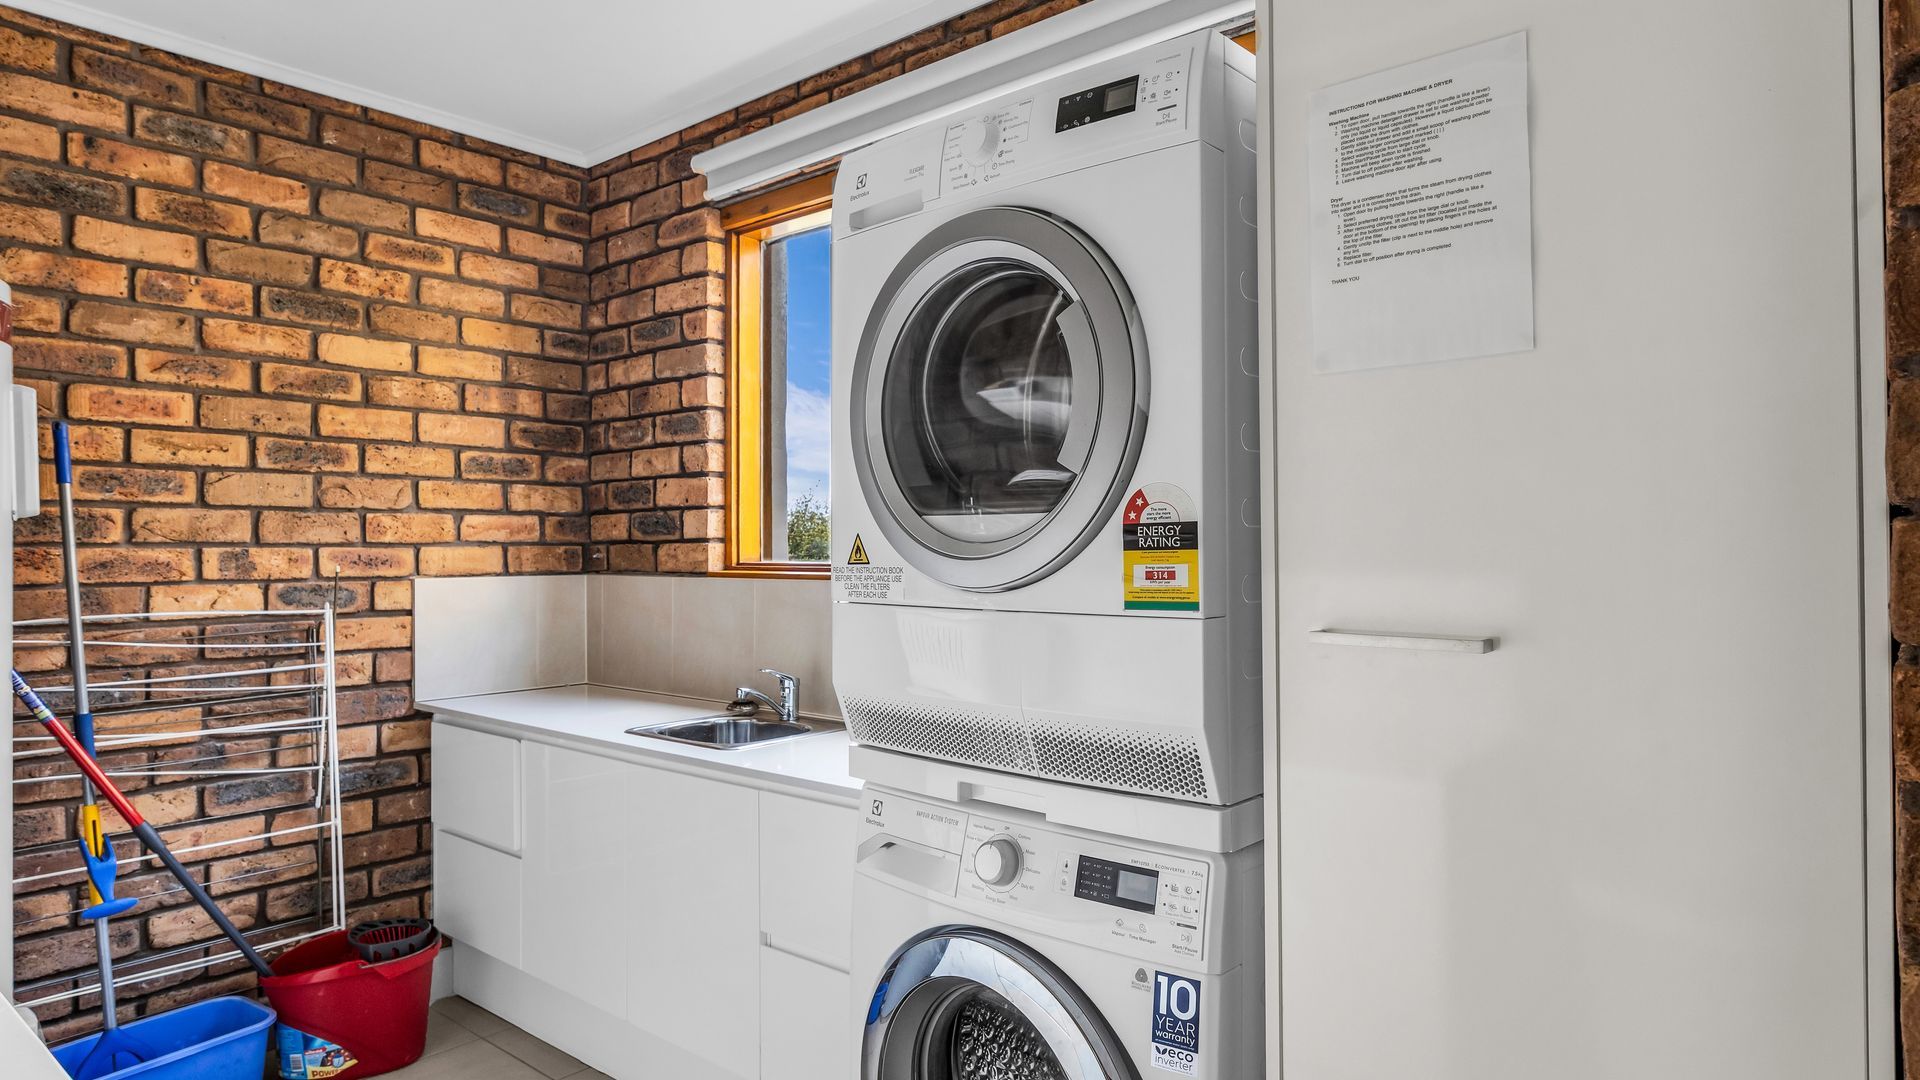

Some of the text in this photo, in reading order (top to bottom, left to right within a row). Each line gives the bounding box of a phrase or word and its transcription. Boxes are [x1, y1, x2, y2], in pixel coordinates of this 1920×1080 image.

[1329, 103, 1365, 116] INSTRUCTIONS
[1377, 93, 1402, 103] WASHING
[1403, 86, 1427, 96] MACHINE
[1329, 112, 1369, 127] Washing Machine
[1137, 525, 1181, 537] ENERGY
[1139, 537, 1180, 548] RATING
[870, 583, 890, 591] FILTERS
[877, 591, 888, 599] USE
[1158, 974, 1197, 1021] 10
[1155, 1014, 1195, 1038] YEAR
[1155, 1030, 1195, 1047] warranty
[1168, 1048, 1194, 1062] eco
[1155, 1055, 1192, 1072] inverter
